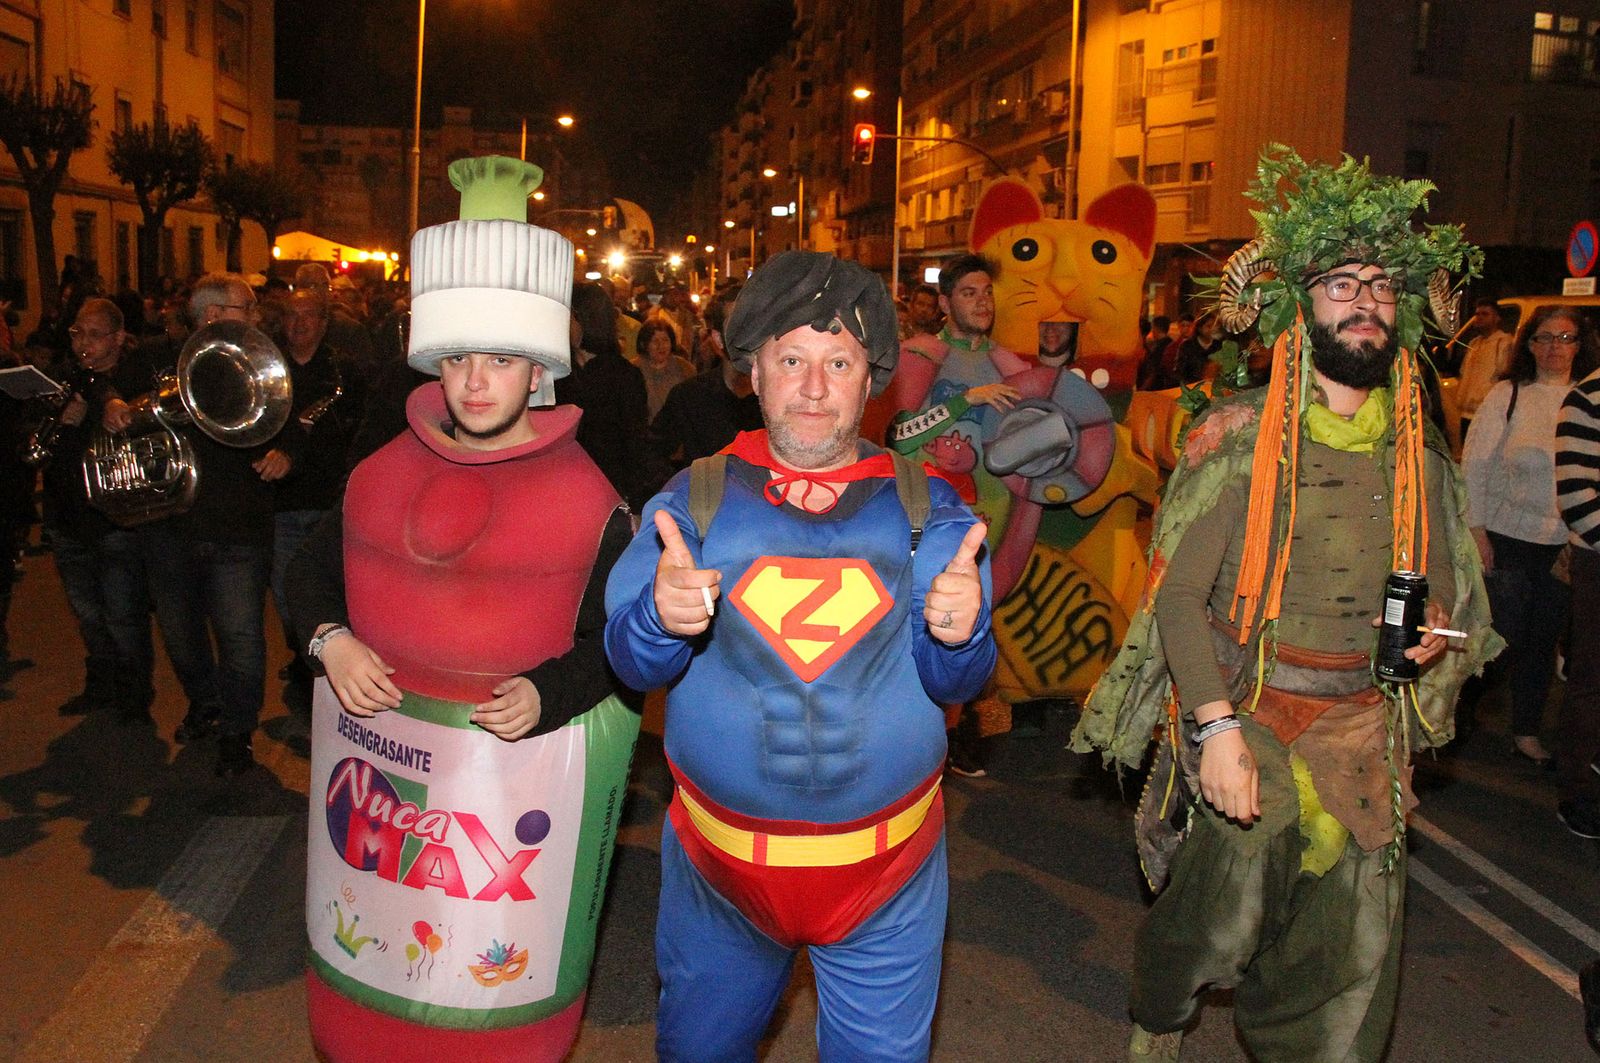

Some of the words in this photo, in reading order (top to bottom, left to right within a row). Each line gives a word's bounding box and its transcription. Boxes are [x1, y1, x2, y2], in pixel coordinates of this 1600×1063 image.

[780, 565, 842, 641] Z
[338, 712, 432, 773] DESENGRASANTE
[327, 757, 451, 843] Nuca
[344, 811, 542, 902] MAX
